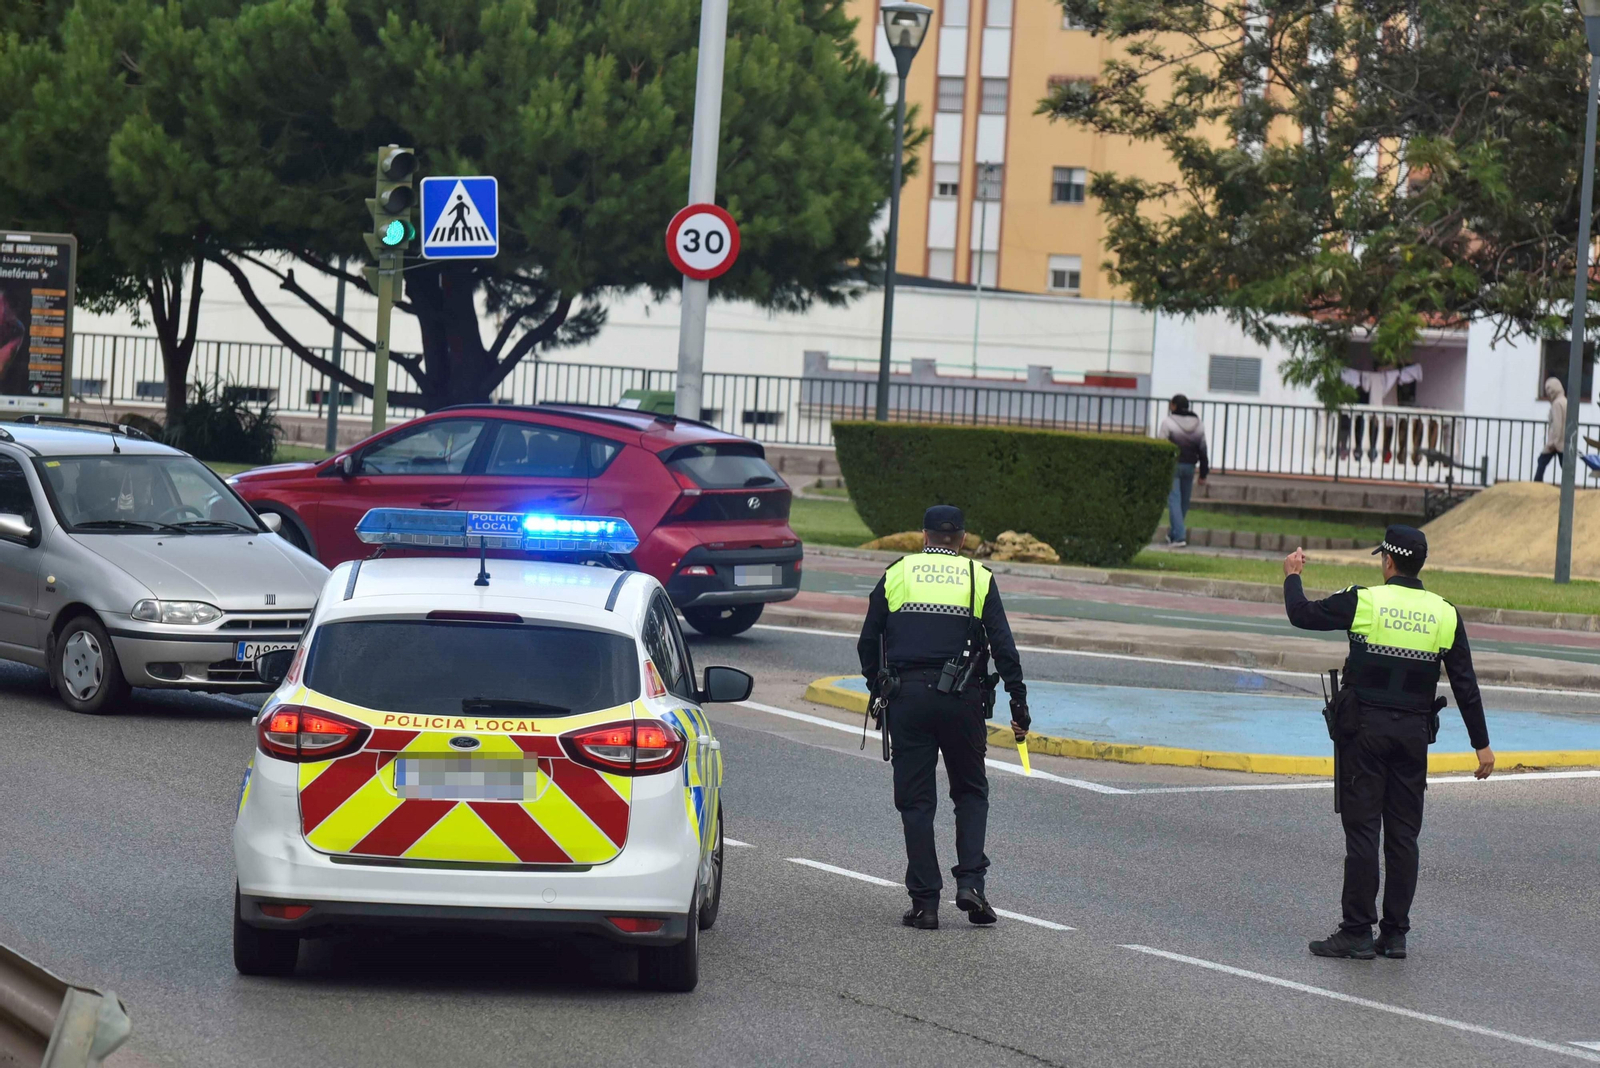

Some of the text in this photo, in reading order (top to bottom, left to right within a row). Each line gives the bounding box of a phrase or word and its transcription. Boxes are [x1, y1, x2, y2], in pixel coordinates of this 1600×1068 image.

[683, 228, 724, 254] 30
[472, 513, 518, 522] POLICIA
[475, 522, 514, 531] LOCAL
[912, 564, 969, 577] POLICIA
[916, 574, 963, 585] LOCAL
[1380, 607, 1436, 624] POLICIA
[1384, 619, 1430, 634] LOCAL
[384, 714, 541, 732] POLICIA LOCAL
